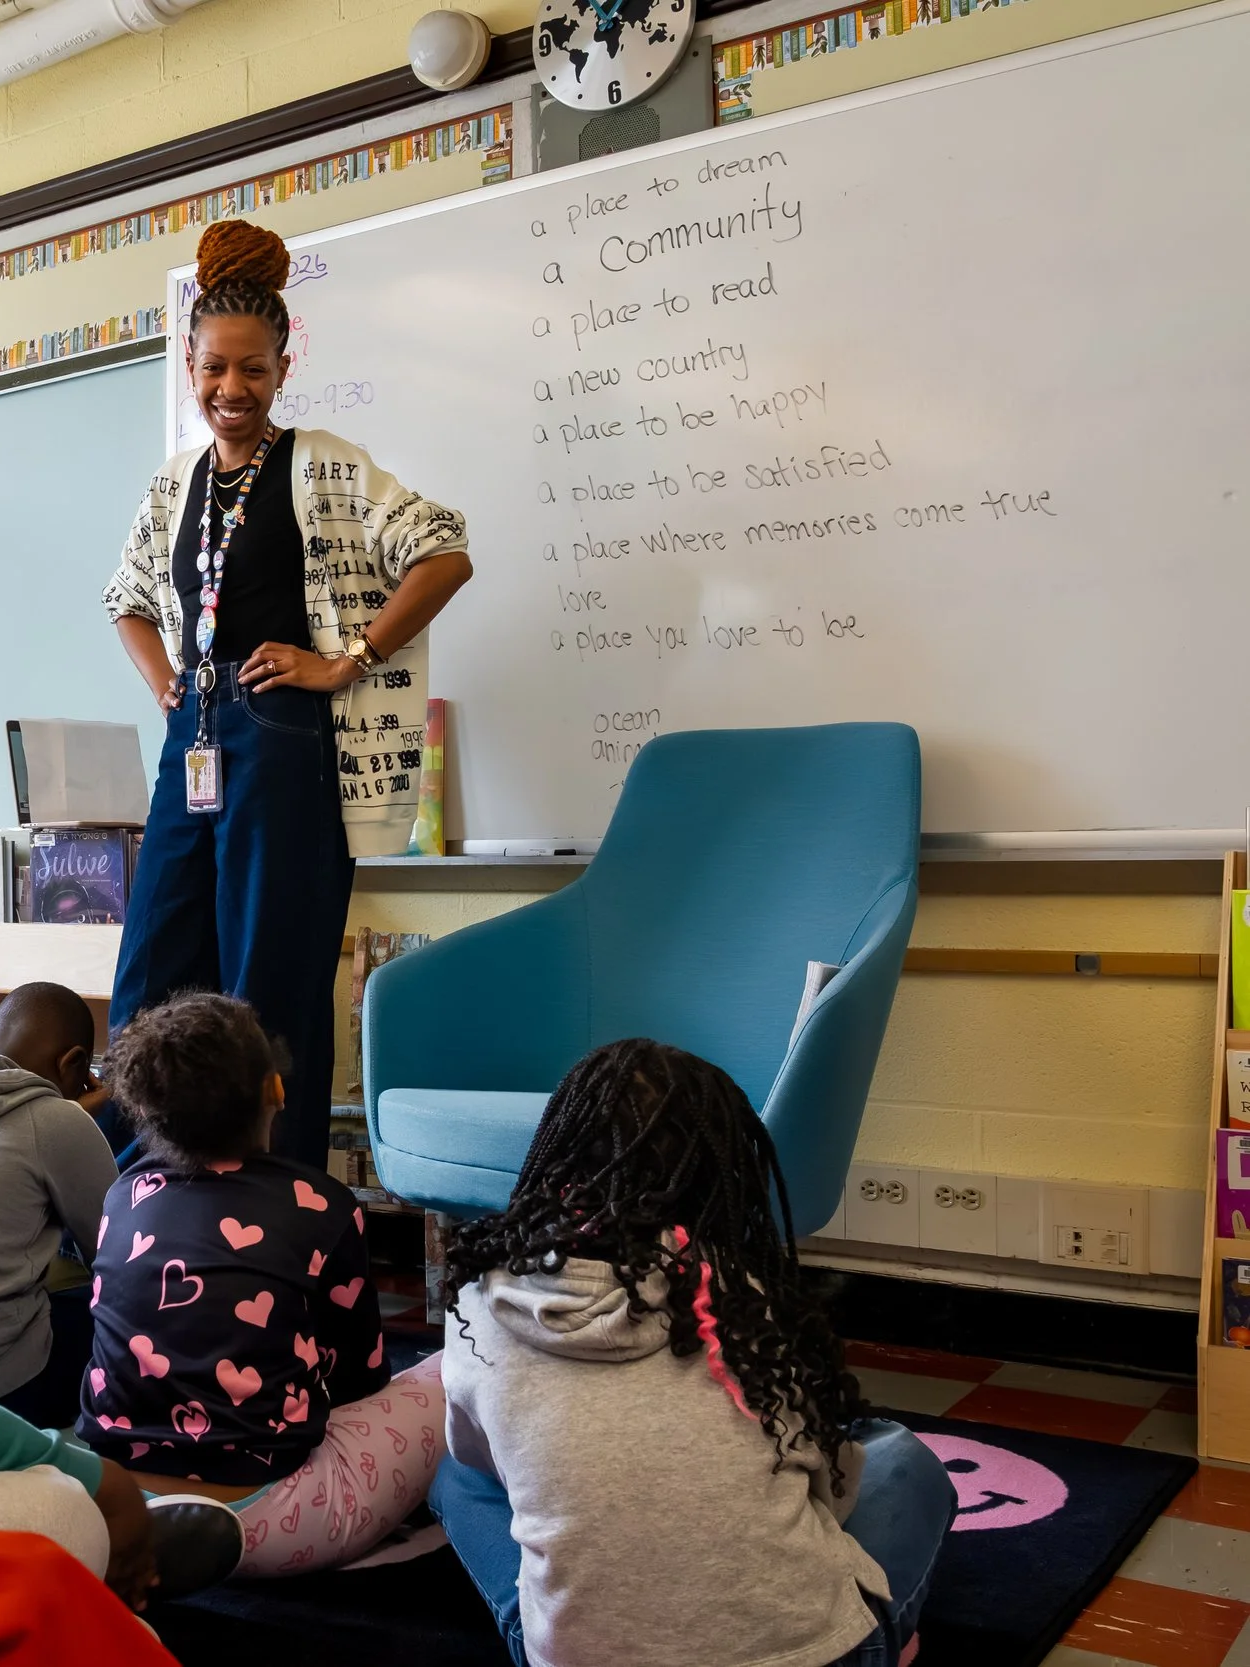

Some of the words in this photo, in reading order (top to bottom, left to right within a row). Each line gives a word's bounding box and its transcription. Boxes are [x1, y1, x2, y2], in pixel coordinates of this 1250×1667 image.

[539, 34, 551, 57] 9
[608, 80, 622, 104] 6
[531, 220, 546, 237] a
[567, 193, 630, 234] place
[647, 178, 679, 196] to
[697, 151, 787, 184] dream
[288, 254, 327, 278] 026
[543, 262, 564, 284] a
[532, 316, 551, 337] a
[570, 300, 641, 352] place
[653, 288, 690, 317] to
[712, 261, 778, 305] read
[533, 380, 553, 401] a
[568, 367, 620, 395] new
[637, 338, 748, 381] country
[532, 424, 549, 444] a
[559, 414, 626, 454] place
[636, 405, 668, 436] to
[676, 402, 718, 430] be
[730, 381, 827, 428] happy
[538, 481, 556, 503] a
[572, 474, 635, 520] place
[647, 470, 680, 499] to
[687, 463, 727, 493] be
[745, 439, 892, 489] satisfied
[542, 543, 558, 562] a
[573, 532, 630, 578] place
[744, 512, 877, 544] memories
[894, 503, 965, 528] come
[980, 490, 1058, 520] true
[557, 584, 607, 612] love
[550, 630, 565, 651] a
[576, 624, 633, 662] place
[646, 625, 688, 660] you
[703, 615, 761, 650] love
[772, 619, 804, 650] to
[821, 611, 865, 638] be
[594, 708, 661, 734] ocean
[342, 782, 359, 802] AN
[71, 832, 108, 840] NYONG'O
[37, 842, 112, 880] Sulwe
